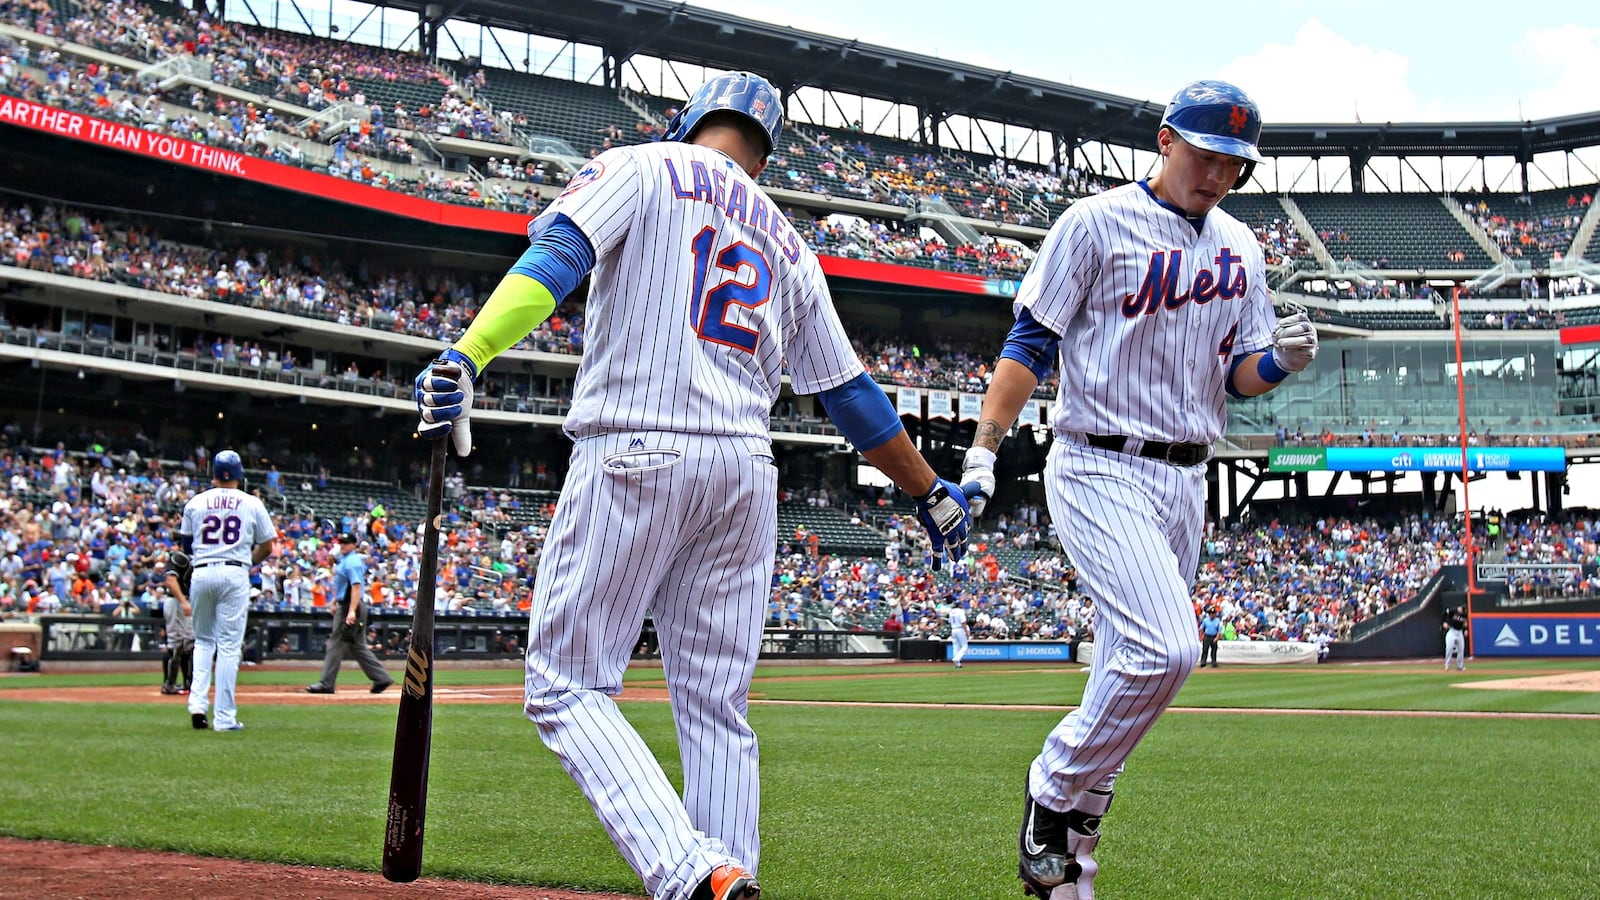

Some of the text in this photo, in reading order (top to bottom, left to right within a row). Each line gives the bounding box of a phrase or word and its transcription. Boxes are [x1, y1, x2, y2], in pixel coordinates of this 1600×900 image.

[0, 97, 247, 176] ARTHER THAN YOU THINK.
[664, 158, 801, 266] LAGARES
[689, 225, 774, 356] 12
[1121, 247, 1248, 320] Mets
[1217, 321, 1239, 365] 4
[1273, 454, 1319, 466] SUBWAY
[207, 495, 242, 511] LONEY
[202, 515, 242, 546] 28
[1025, 646, 1062, 656] HONDA
[1529, 624, 1600, 645] DEL
